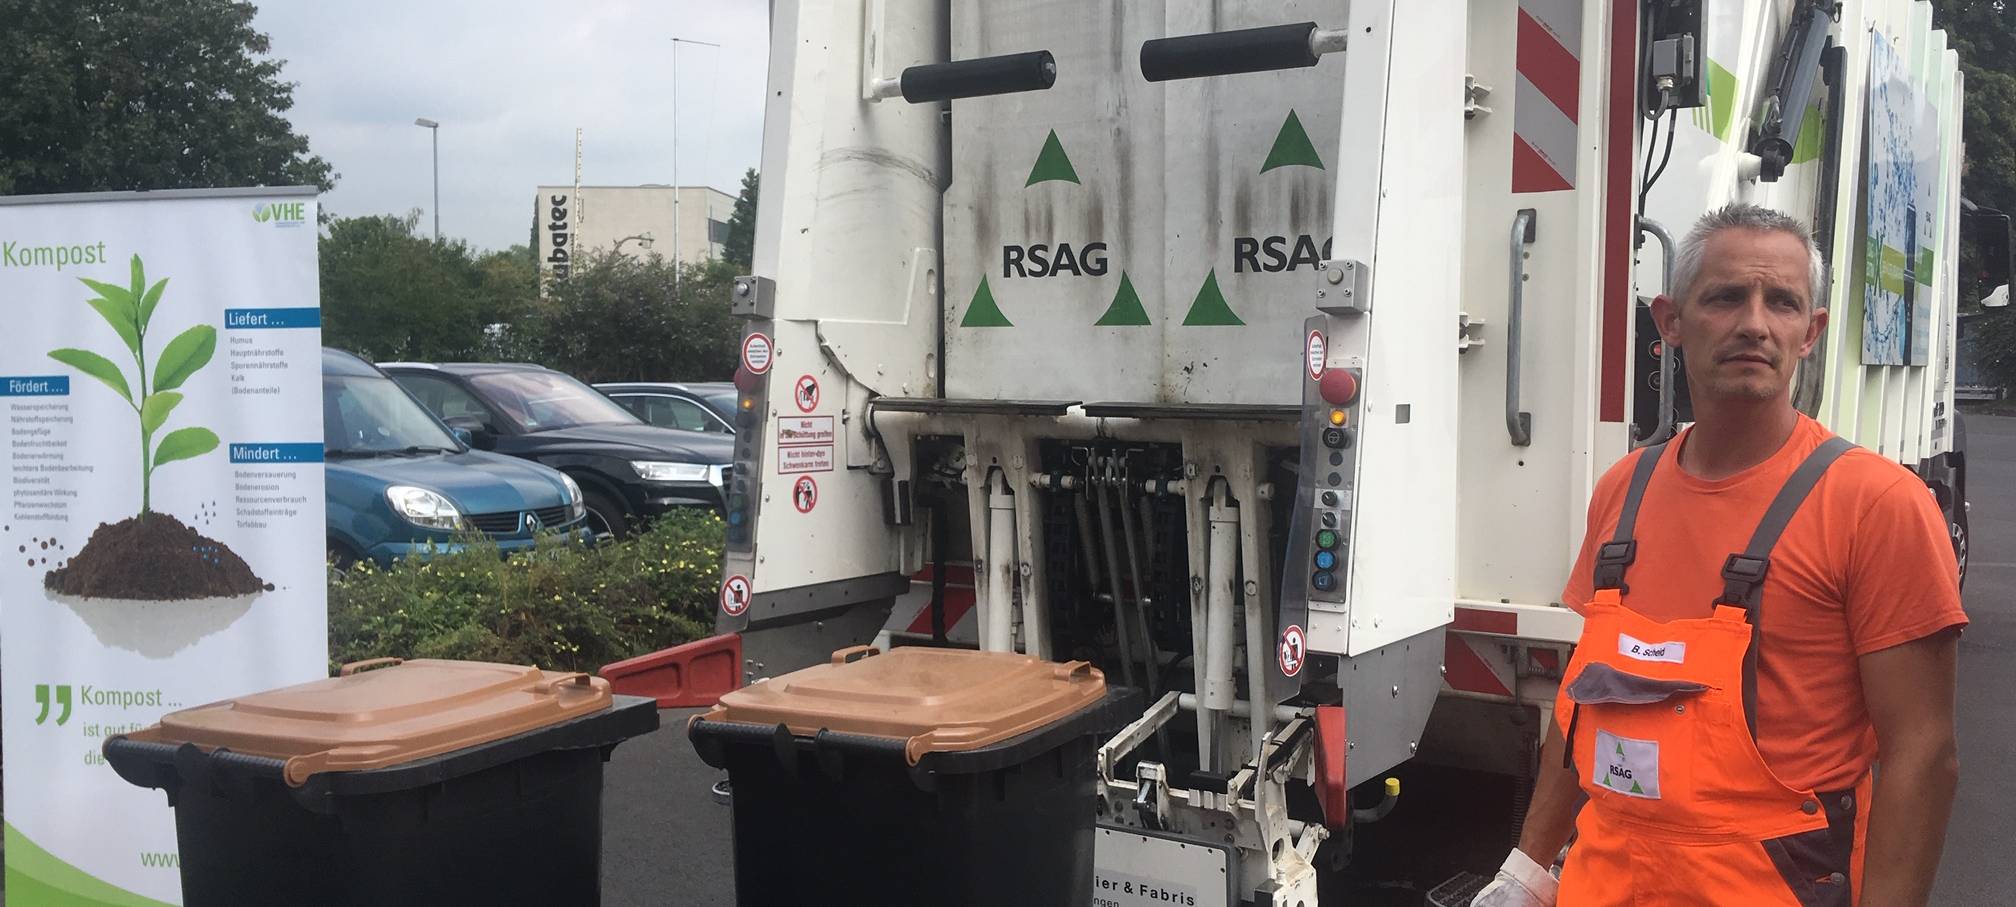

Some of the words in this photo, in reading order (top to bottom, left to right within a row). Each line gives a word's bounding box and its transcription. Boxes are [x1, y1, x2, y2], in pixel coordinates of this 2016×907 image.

[271, 203, 305, 221] VHE
[547, 194, 569, 281] ubatec
[2, 240, 107, 272] Kompost
[1003, 242, 1108, 278] RSAG
[1234, 234, 1333, 273] RSA
[229, 311, 268, 326] Liefert
[230, 336, 253, 345] Humus
[230, 349, 285, 358] Hauptnährstoffe
[231, 361, 289, 371] Spurennährstoffe
[231, 374, 245, 382] Kalk
[9, 379, 49, 394] Fördert
[232, 386, 281, 395] (Bodenanteile)
[233, 446, 280, 460] Mindert
[1631, 645, 1641, 655] B.
[1642, 647, 1665, 657] Scheid
[81, 685, 163, 710] Kompost
[83, 721, 99, 737] ist
[84, 749, 105, 766] die
[1609, 764, 1632, 780] RSAG
[1095, 875, 1118, 891] ier
[1123, 881, 1134, 895] &
[1139, 884, 1195, 907] Fabris
[1094, 897, 1120, 907] ngen
